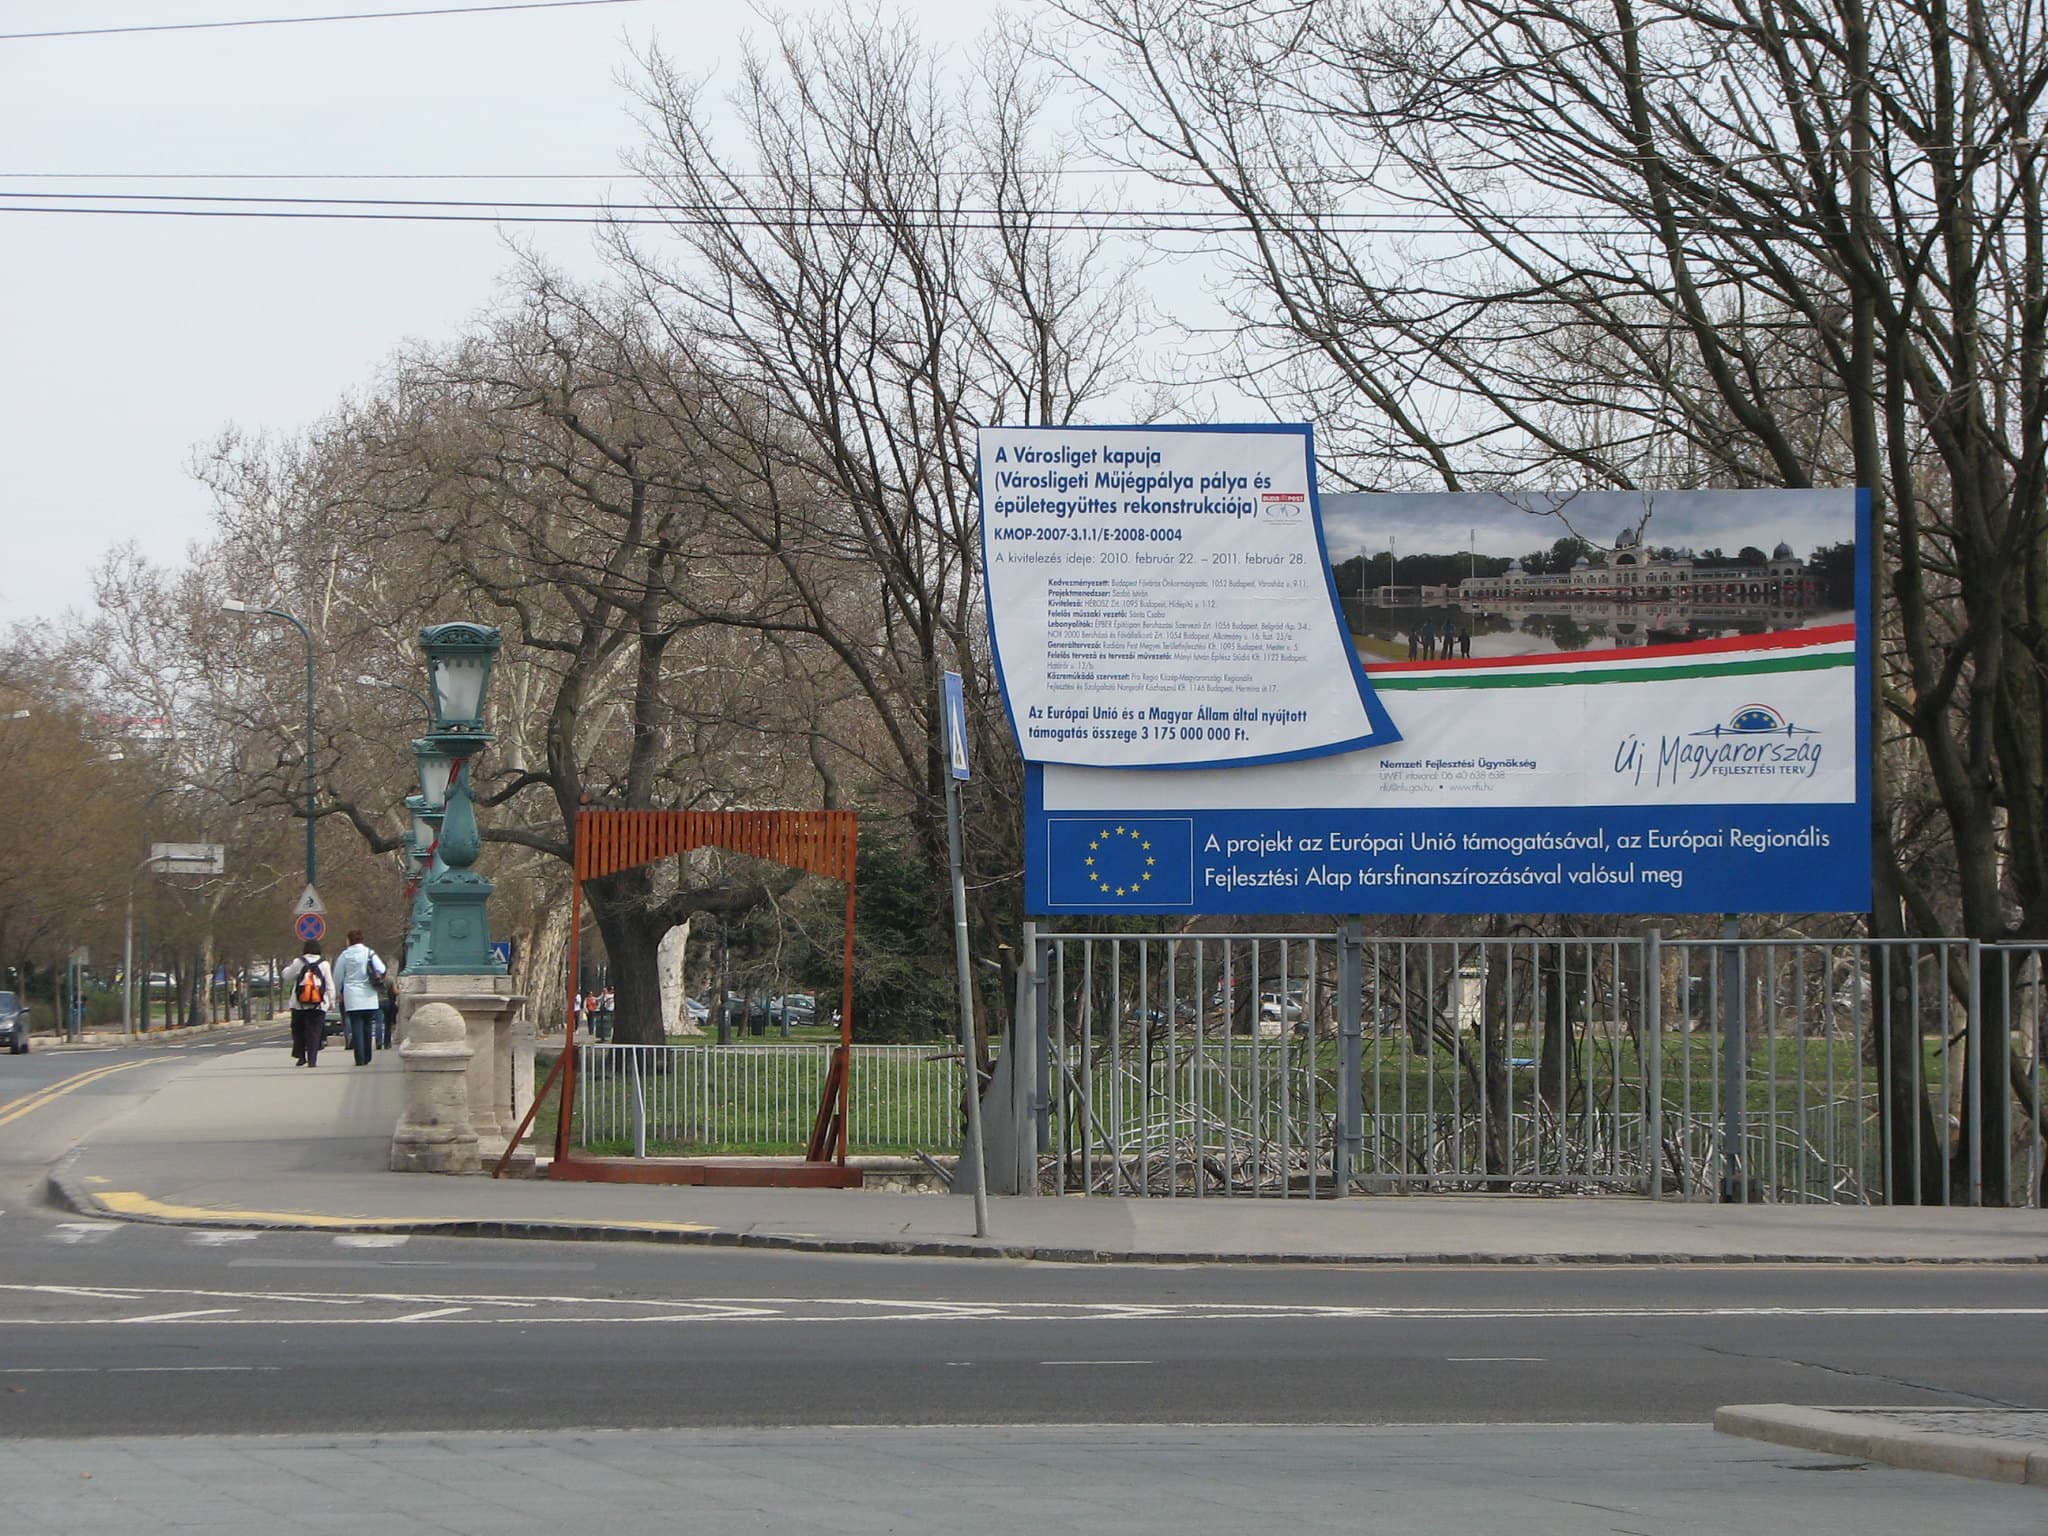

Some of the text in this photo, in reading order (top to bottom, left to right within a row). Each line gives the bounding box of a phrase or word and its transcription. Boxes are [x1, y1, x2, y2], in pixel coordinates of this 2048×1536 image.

[995, 445, 1161, 469] A Városliget kapuja
[995, 470, 1272, 494] (Városligeti Műjégpálya pálya és
[994, 495, 1258, 519] épületegyüttes rekonstrukciója)
[994, 528, 1182, 542] KMOP-2007-3.1.1/E-2008-0004
[995, 553, 1004, 563] A
[1008, 552, 1062, 563] kivitelezés
[1066, 552, 1096, 566] ideje:
[1100, 553, 1131, 564] 2010.
[1135, 552, 1174, 564] február
[1212, 553, 1241, 564] 2011.
[1245, 552, 1284, 564] február
[1289, 553, 1306, 564] 28.
[1048, 610, 1070, 618] Felelős
[1073, 610, 1101, 618] műszaki
[1048, 651, 1070, 659] Felelős
[1099, 651, 1107, 659] és
[1029, 705, 1307, 726] Az Európai Unió és a Magyar Állam által nyújtott
[1029, 726, 1249, 743] támogatás összege 3 175 000 000 Ft.
[1380, 757, 1537, 771] Nemzeti Fejlesztési Ügynökség
[1614, 734, 1822, 788] Új Magyarország
[1712, 764, 1806, 776] FEJLESZTÉSI TERV
[1204, 826, 1830, 857] A projekt az Európai Unió támogatásával, az Európai Regionális
[1205, 862, 1683, 892] Fejlesztési Alap társfinanszírozásával valósul meg
